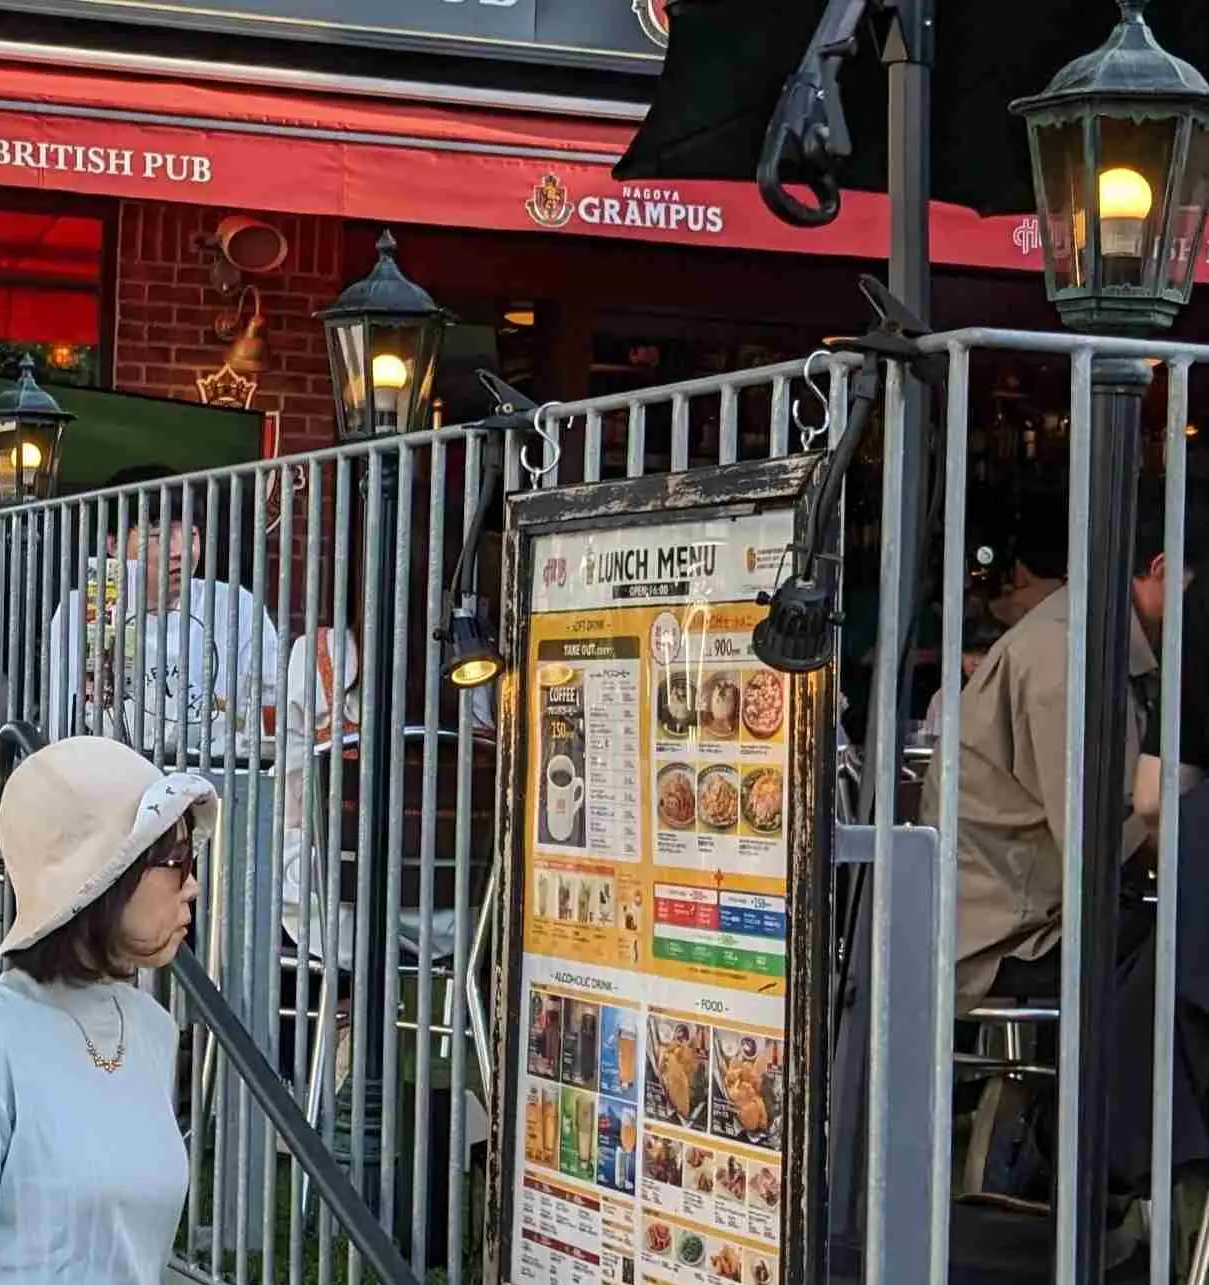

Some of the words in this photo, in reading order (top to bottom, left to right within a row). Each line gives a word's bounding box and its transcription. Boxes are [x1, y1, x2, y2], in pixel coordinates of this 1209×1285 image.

[142, 151, 212, 183] PUB
[622, 186, 680, 202] NAGOYA
[578, 197, 723, 233] GRAMPUS
[597, 548, 649, 583] LUNCH
[657, 544, 716, 579] MENU
[714, 638, 733, 657] 900
[549, 687, 575, 703] COFFEE
[701, 998, 724, 1013] FOOD
